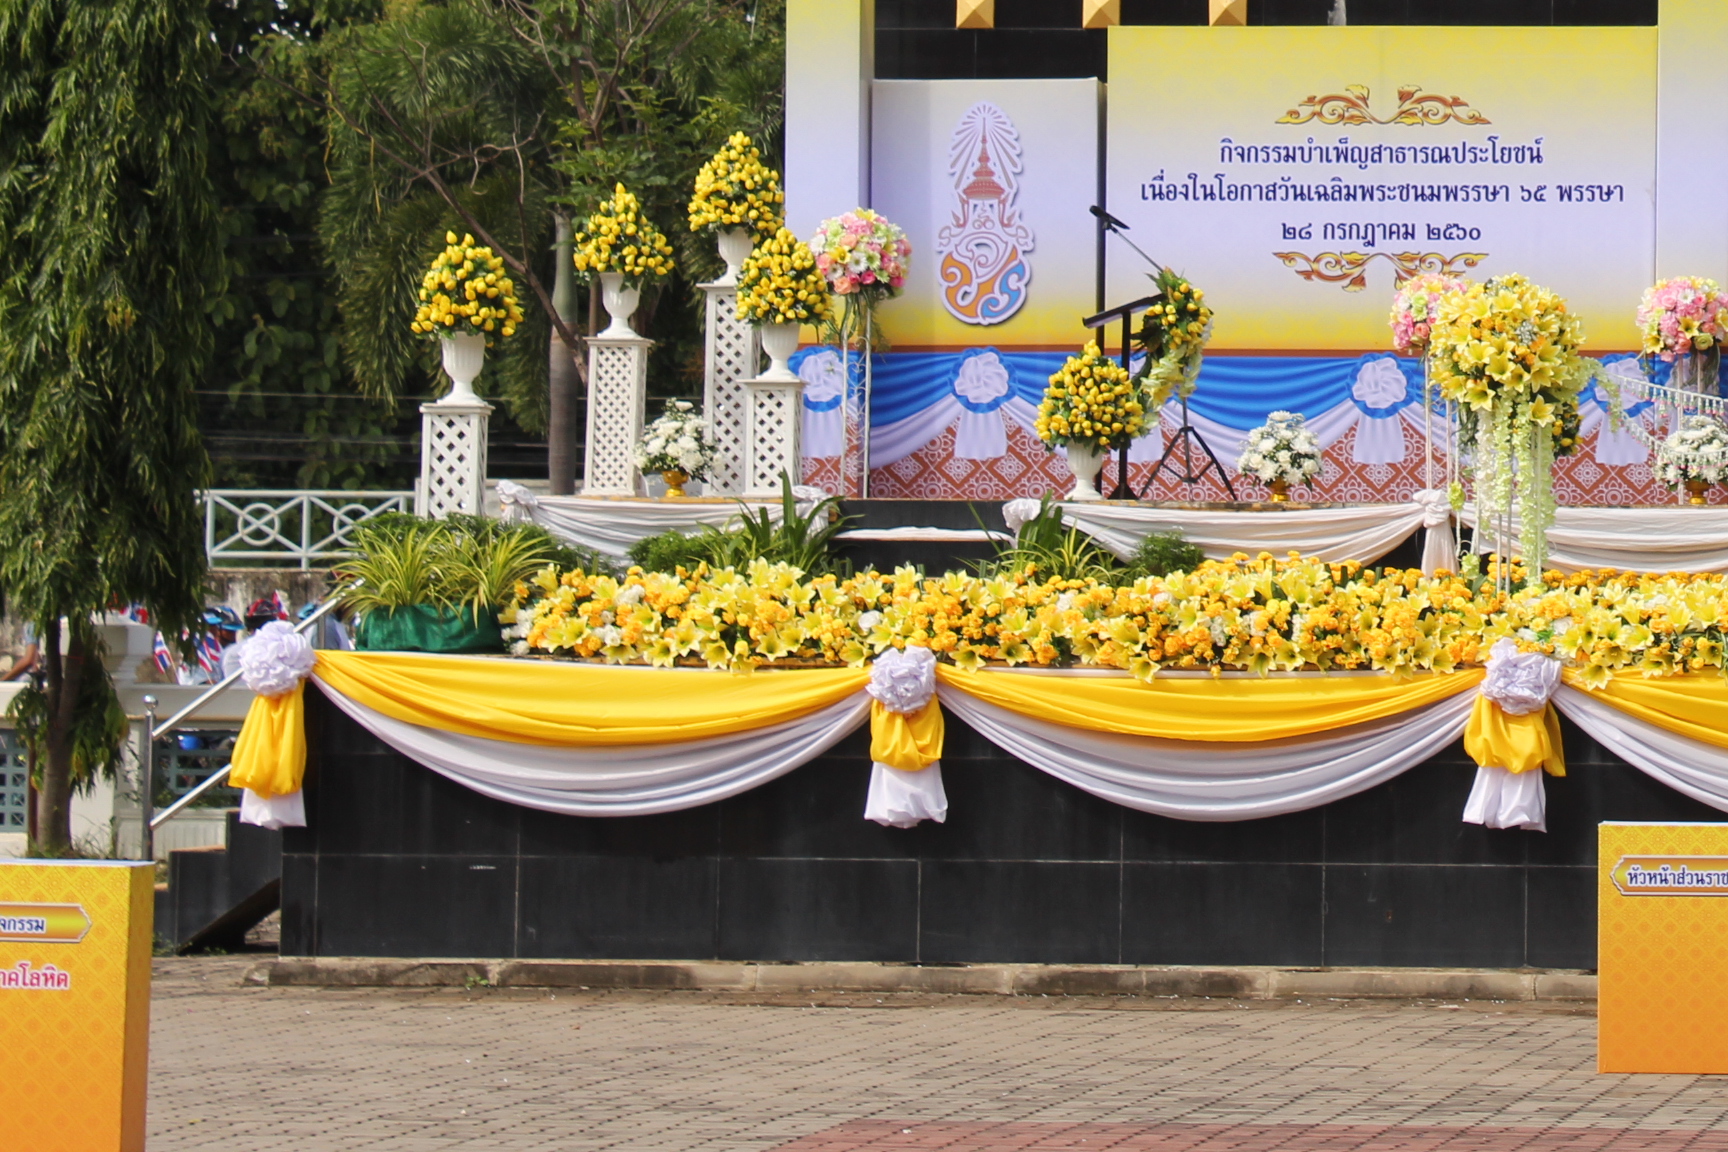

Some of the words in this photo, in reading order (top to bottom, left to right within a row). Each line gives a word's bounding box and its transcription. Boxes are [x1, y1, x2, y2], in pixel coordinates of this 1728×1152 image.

[1219, 135, 1545, 170] กิจกรรมบำเพ็ญสาธารณประโยชน์
[1140, 168, 1510, 203] เนื่องในโอกาสวันเฉลิมพระชนมพรรษา
[1519, 183, 1547, 203] ๖๕
[1555, 183, 1625, 203] พรรษา
[1281, 222, 1313, 241] ๒๘
[1323, 222, 1416, 248] กรกฎาคม
[1425, 222, 1482, 242] ๒๕๖๐
